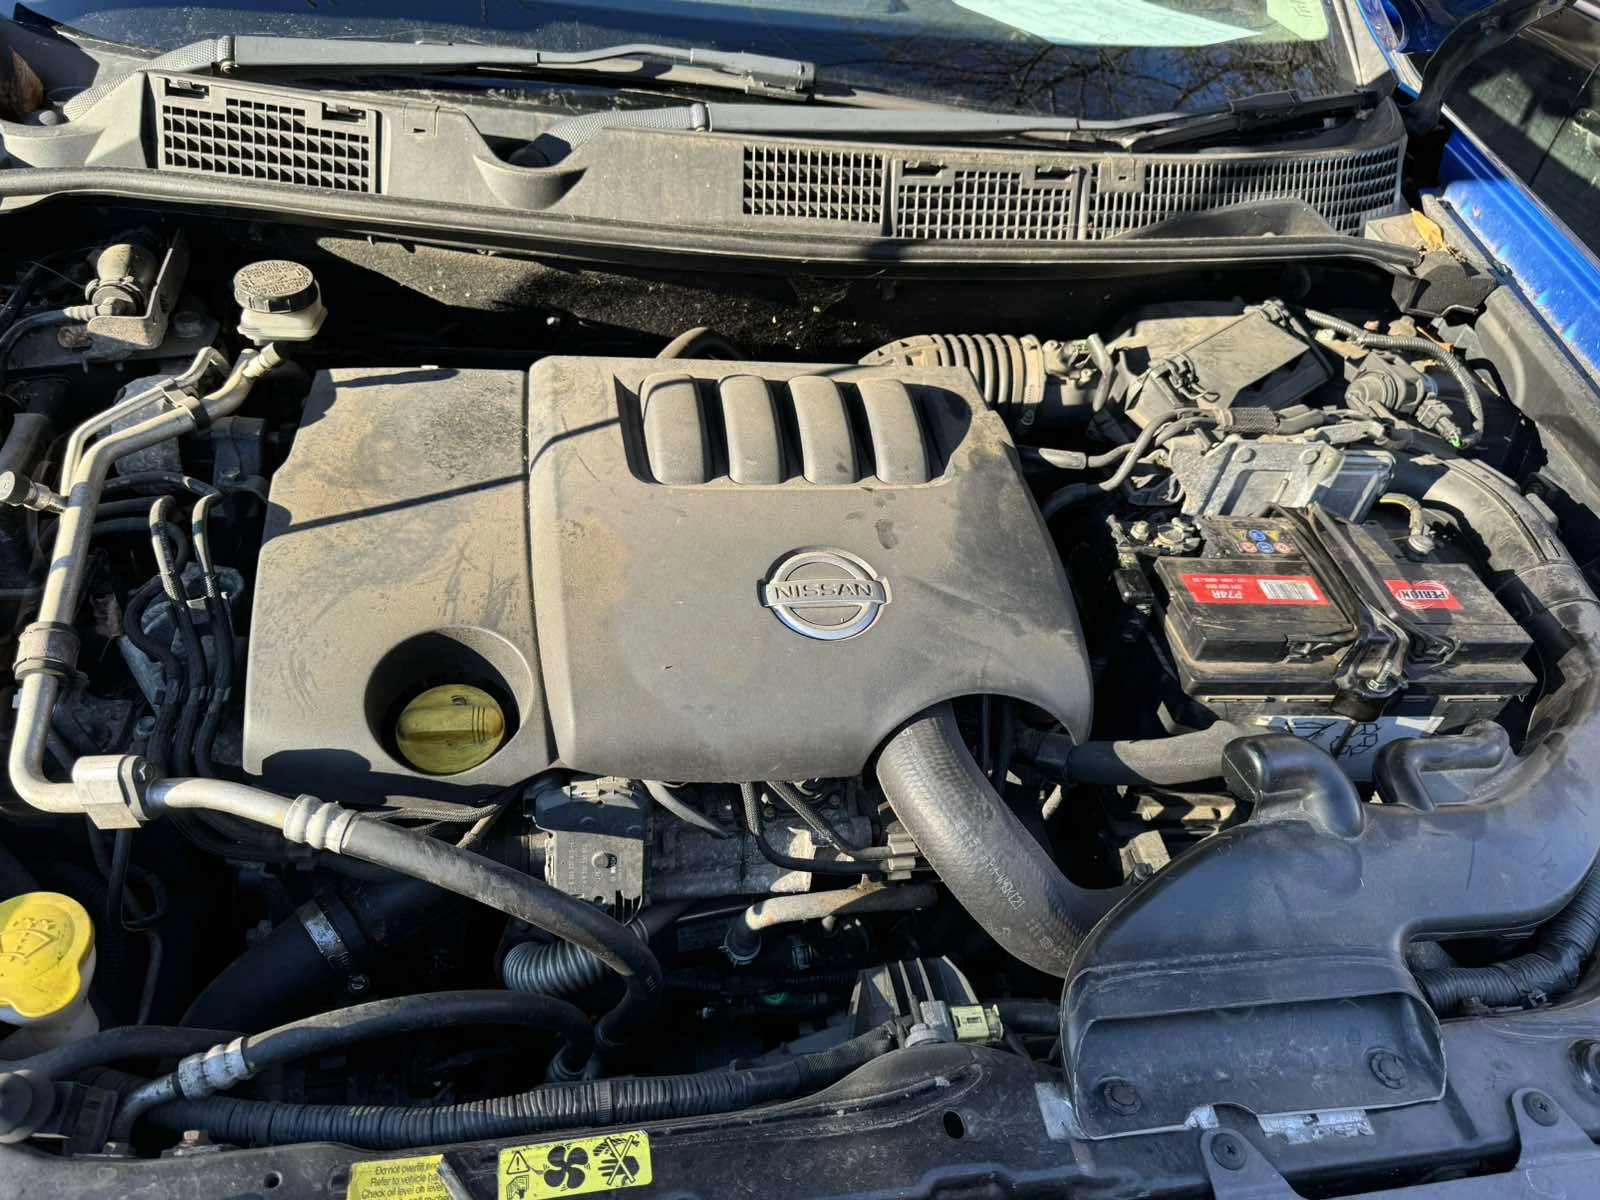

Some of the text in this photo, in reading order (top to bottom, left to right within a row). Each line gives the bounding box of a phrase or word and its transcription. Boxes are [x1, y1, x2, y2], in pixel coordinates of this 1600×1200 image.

[774, 583, 873, 600] NISSAN
[361, 1189, 385, 1199] Check
[386, 1186, 396, 1197] oil
[397, 1185, 414, 1197] level
